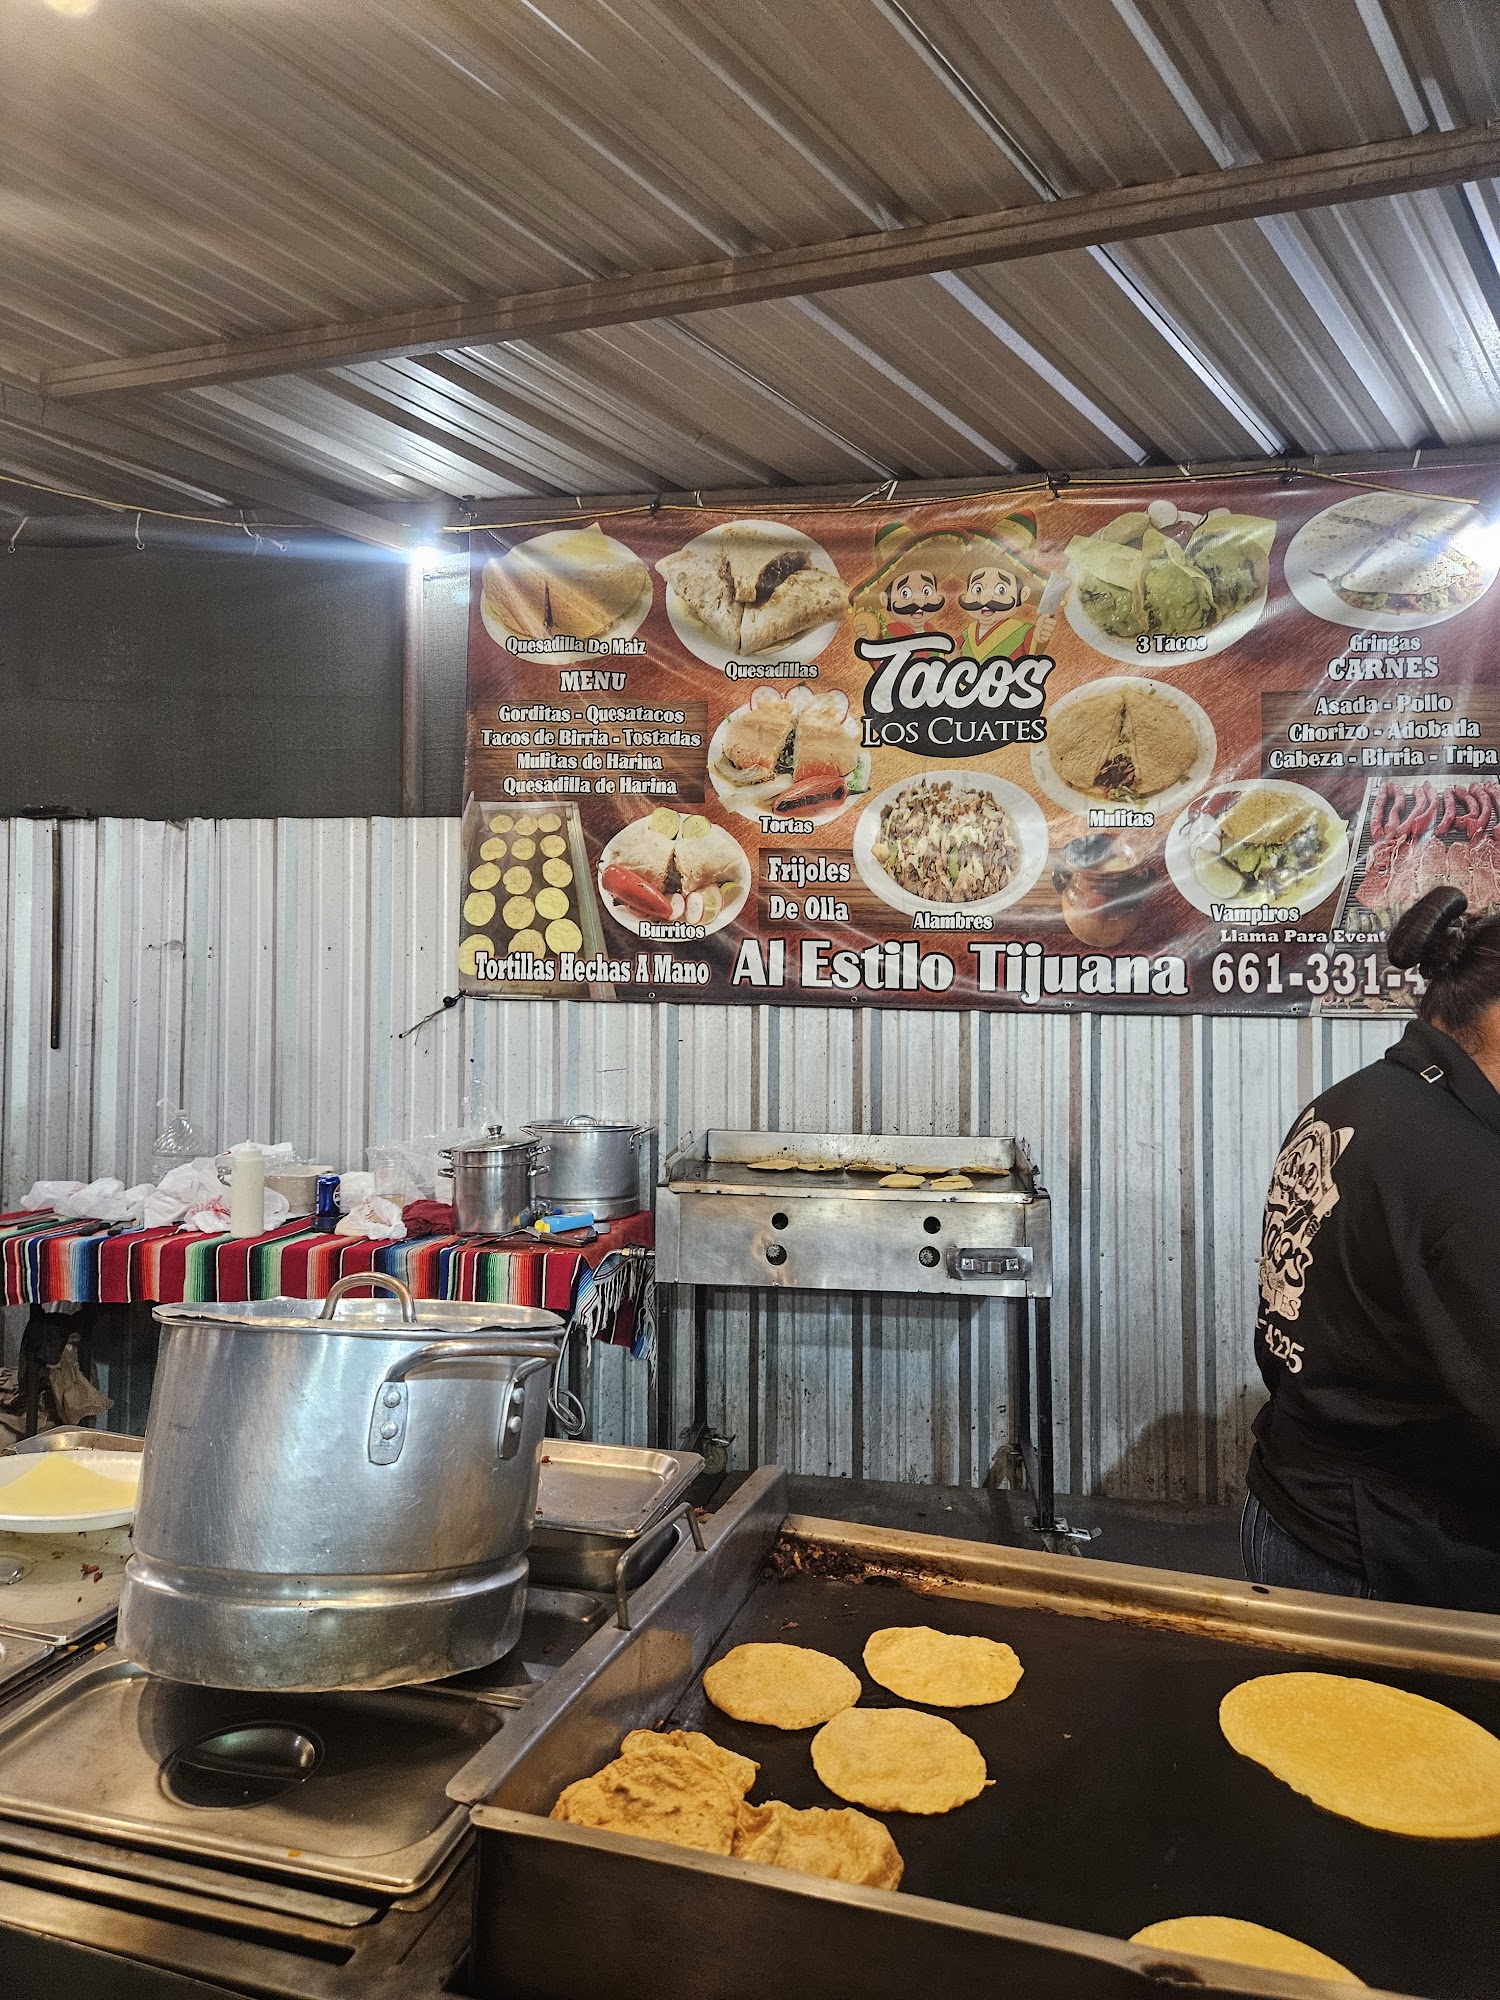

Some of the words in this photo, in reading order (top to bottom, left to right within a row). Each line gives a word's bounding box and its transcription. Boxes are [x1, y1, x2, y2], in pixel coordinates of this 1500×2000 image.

[506, 636, 585, 654] Quesadilla
[587, 639, 609, 654] De
[611, 638, 647, 656] Maiz
[1136, 635, 1150, 653] 3
[1152, 635, 1208, 653] Tacos
[1349, 634, 1422, 655] Gringas
[725, 662, 819, 680] Quesadillas
[859, 635, 1054, 714] Tacos
[1328, 656, 1440, 681] CARNES
[559, 670, 627, 692] MENU
[498, 706, 571, 723] Gorditas
[585, 706, 685, 724] Quesatacos
[1314, 697, 1379, 716] Asada
[1395, 694, 1453, 715] Pollo
[481, 729, 531, 747] Tacos
[533, 729, 555, 747] de
[557, 729, 610, 747] Birria
[623, 730, 702, 748] Tostadas
[863, 718, 919, 747] LOS
[927, 716, 1046, 745] CUATES
[1288, 722, 1370, 743] Chorizo
[1387, 718, 1481, 740] Adobada
[517, 752, 578, 770] Mulitas
[580, 752, 603, 770] de
[605, 753, 663, 771] Harina
[1268, 749, 1345, 770] Cabeza
[1361, 747, 1425, 767] Birria
[1444, 745, 1498, 768] Tripa
[502, 776, 591, 795] Quesadilla
[594, 777, 616, 794] de
[618, 777, 678, 796] Harina
[759, 816, 813, 834] Tortas
[1089, 809, 1155, 828] Mulitas
[767, 856, 851, 889] Frijoles
[768, 895, 798, 920] De
[803, 896, 849, 923] Olla
[1210, 904, 1300, 925] Vampiros
[639, 921, 705, 940] Burritos
[912, 911, 994, 931] Alambres
[1220, 930, 1279, 943] Llama
[1283, 930, 1328, 944] Para
[1332, 930, 1387, 944] Event
[475, 951, 555, 982] Tortillas
[558, 952, 632, 983] Hechas
[634, 954, 650, 984] A
[653, 954, 710, 985] Mano
[732, 939, 784, 988] Al
[801, 940, 956, 991] Estilo
[968, 942, 1189, 1005] Tijuana
[1212, 952, 1428, 995] 661-331-4
